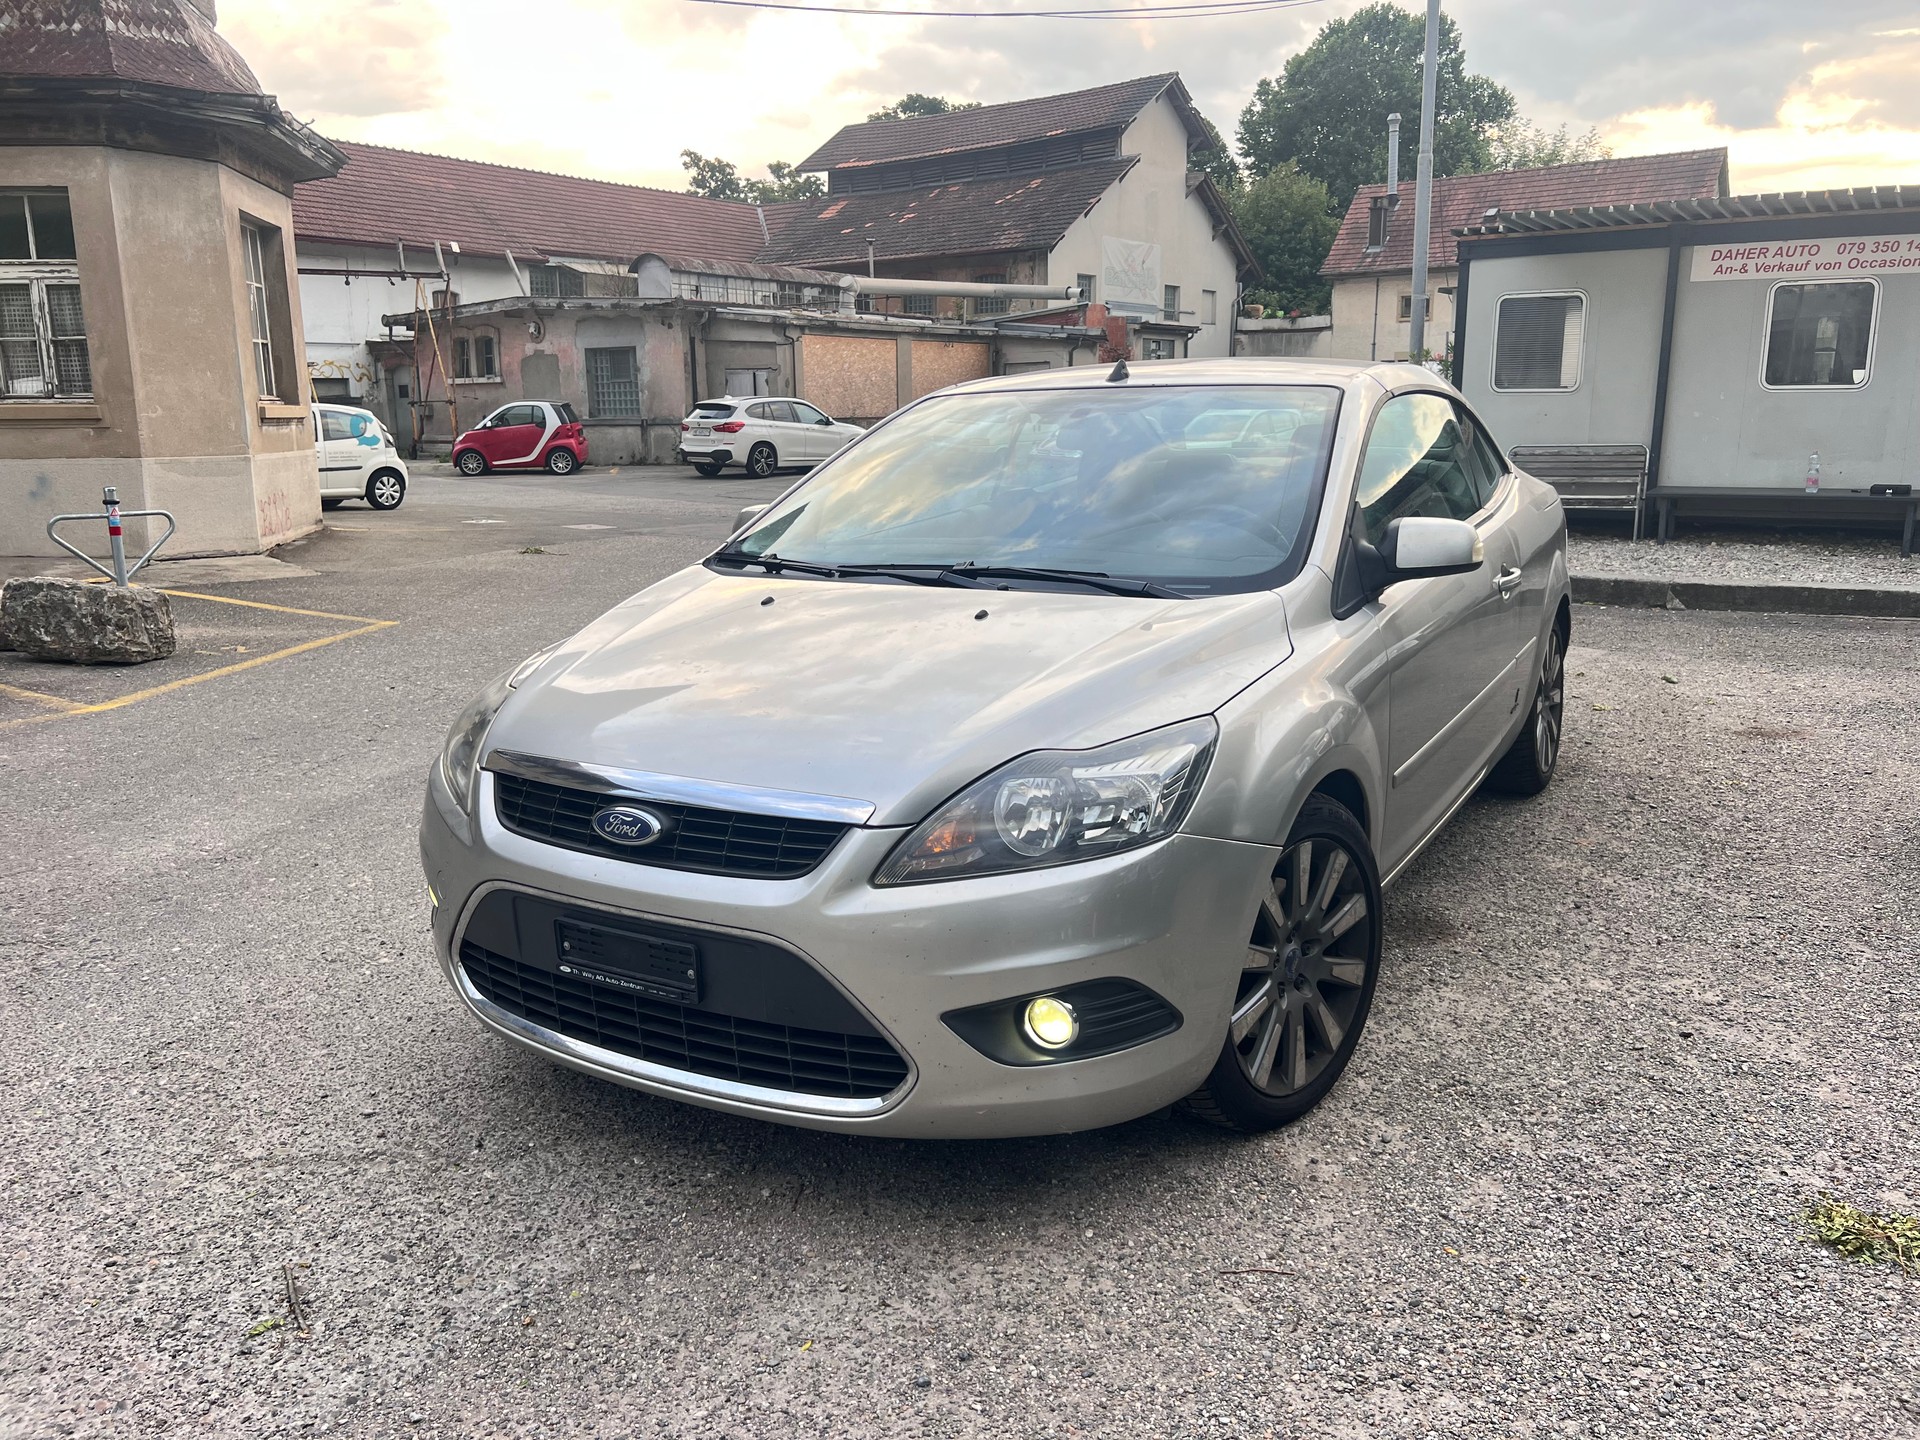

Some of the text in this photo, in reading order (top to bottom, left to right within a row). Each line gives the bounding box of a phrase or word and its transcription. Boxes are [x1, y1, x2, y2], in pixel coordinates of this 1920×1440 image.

[1711, 247, 1769, 262] DAHER
[1772, 244, 1821, 259] AUTO
[1837, 241, 1866, 255] 079
[1871, 240, 1900, 253] 350
[1713, 255, 1920, 275] An-& Verkauf von Occasion
[604, 813, 641, 837] Ford
